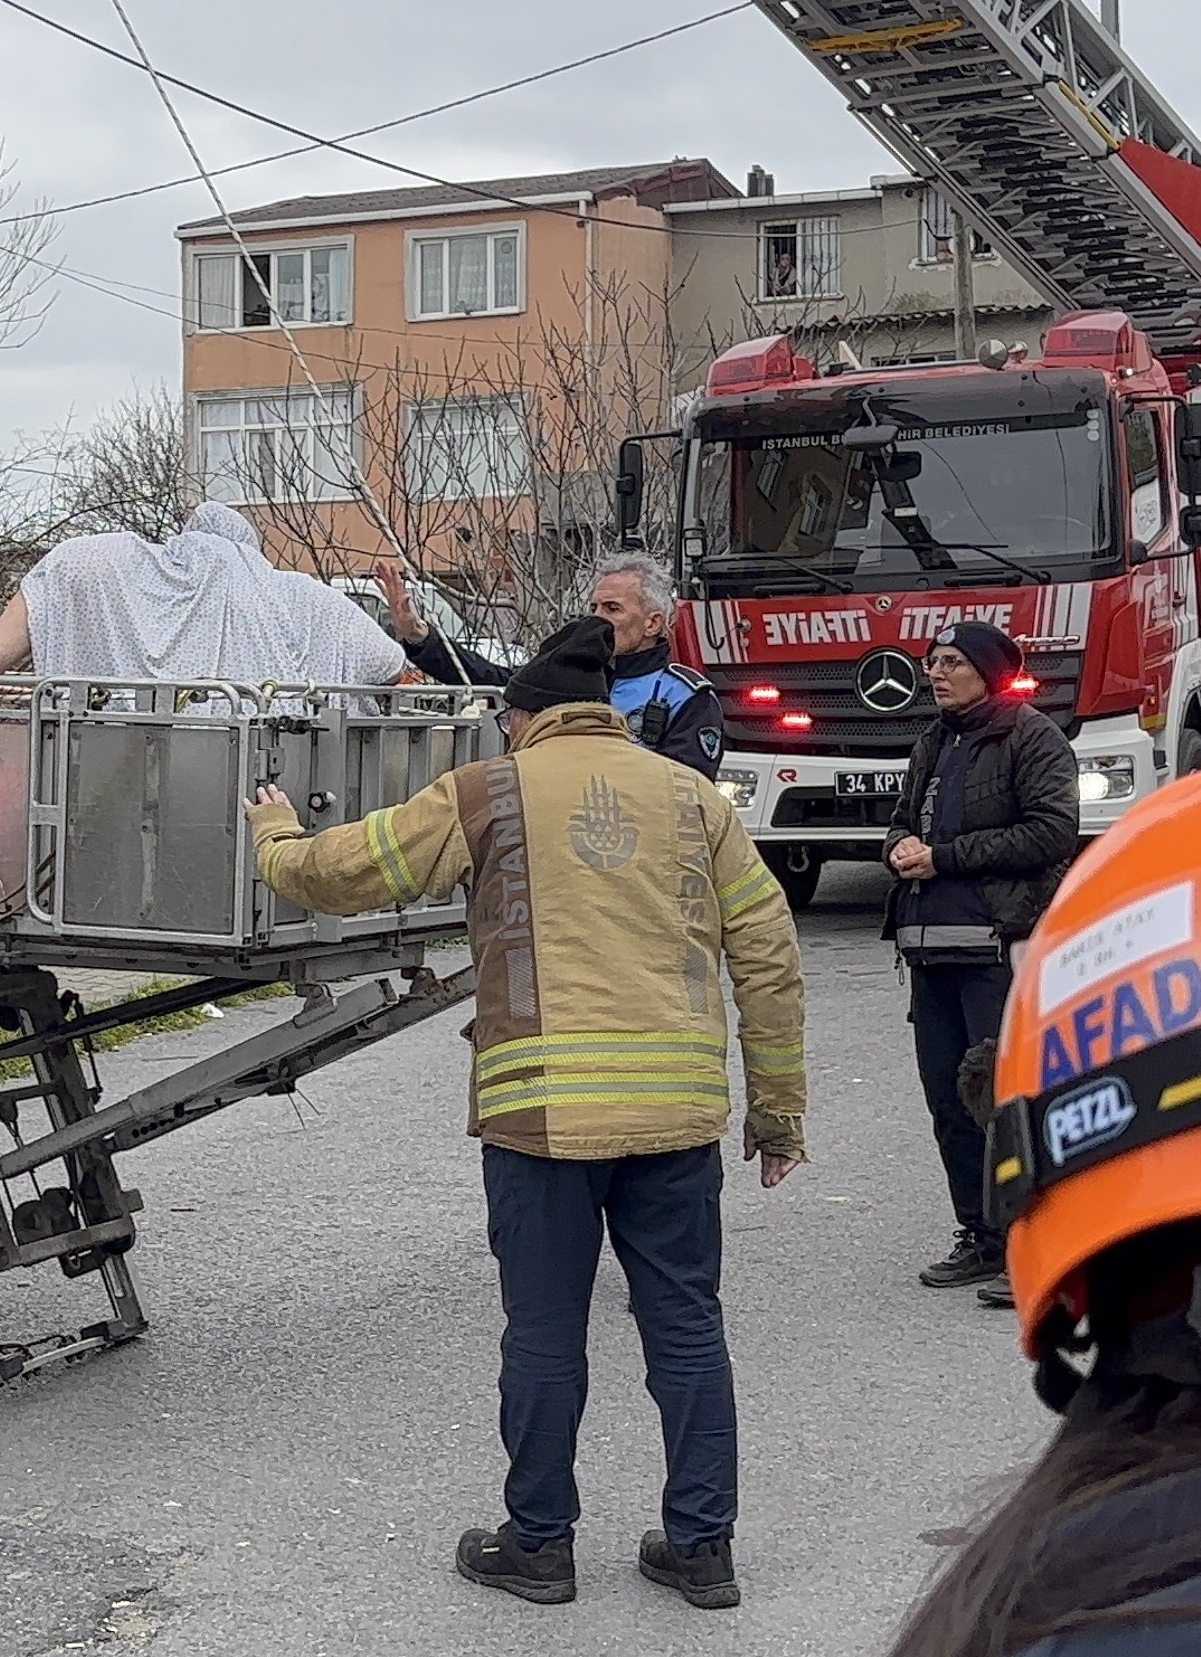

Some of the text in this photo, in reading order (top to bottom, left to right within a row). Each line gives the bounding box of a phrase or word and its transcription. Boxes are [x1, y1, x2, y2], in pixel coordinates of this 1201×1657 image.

[845, 774, 867, 793] 34
[1041, 958, 1201, 1090] AFAD
[1049, 1084, 1138, 1168] PETZL
